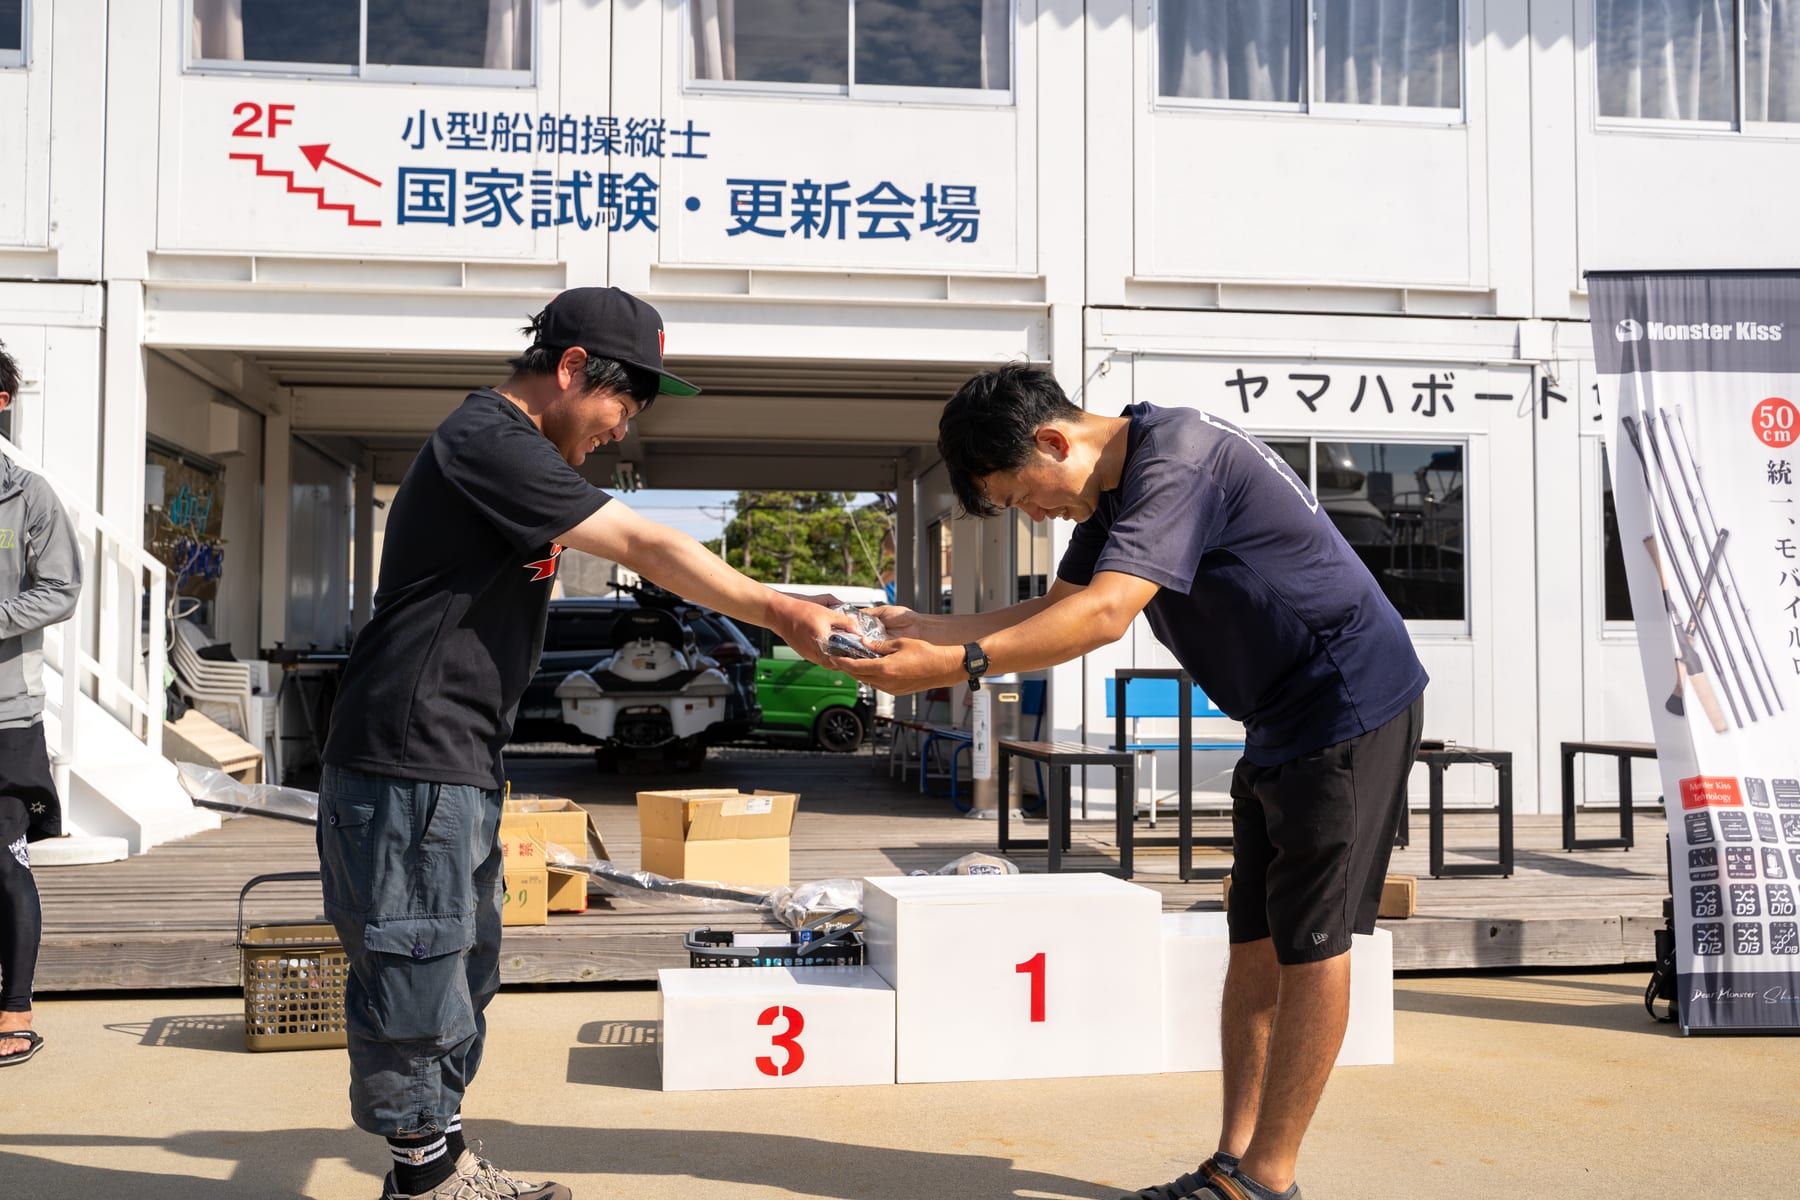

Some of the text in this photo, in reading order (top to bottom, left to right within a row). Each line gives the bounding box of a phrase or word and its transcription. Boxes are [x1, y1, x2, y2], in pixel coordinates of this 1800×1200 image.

[232, 102, 295, 138] 2F
[402, 110, 710, 159] 小型船舶操縦士
[397, 167, 981, 242] 国家試験・更新会場
[1646, 321, 1782, 341] Monster Kiss
[1760, 405, 1793, 429] 50
[1763, 430, 1791, 442] cm
[1696, 904, 1717, 916] D8
[1736, 903, 1756, 915] D9
[1771, 903, 1793, 915] D10
[1698, 942, 1721, 954] D12
[1738, 942, 1760, 953] D13
[1016, 952, 1046, 1023] 1
[754, 1005, 805, 1077] 3
